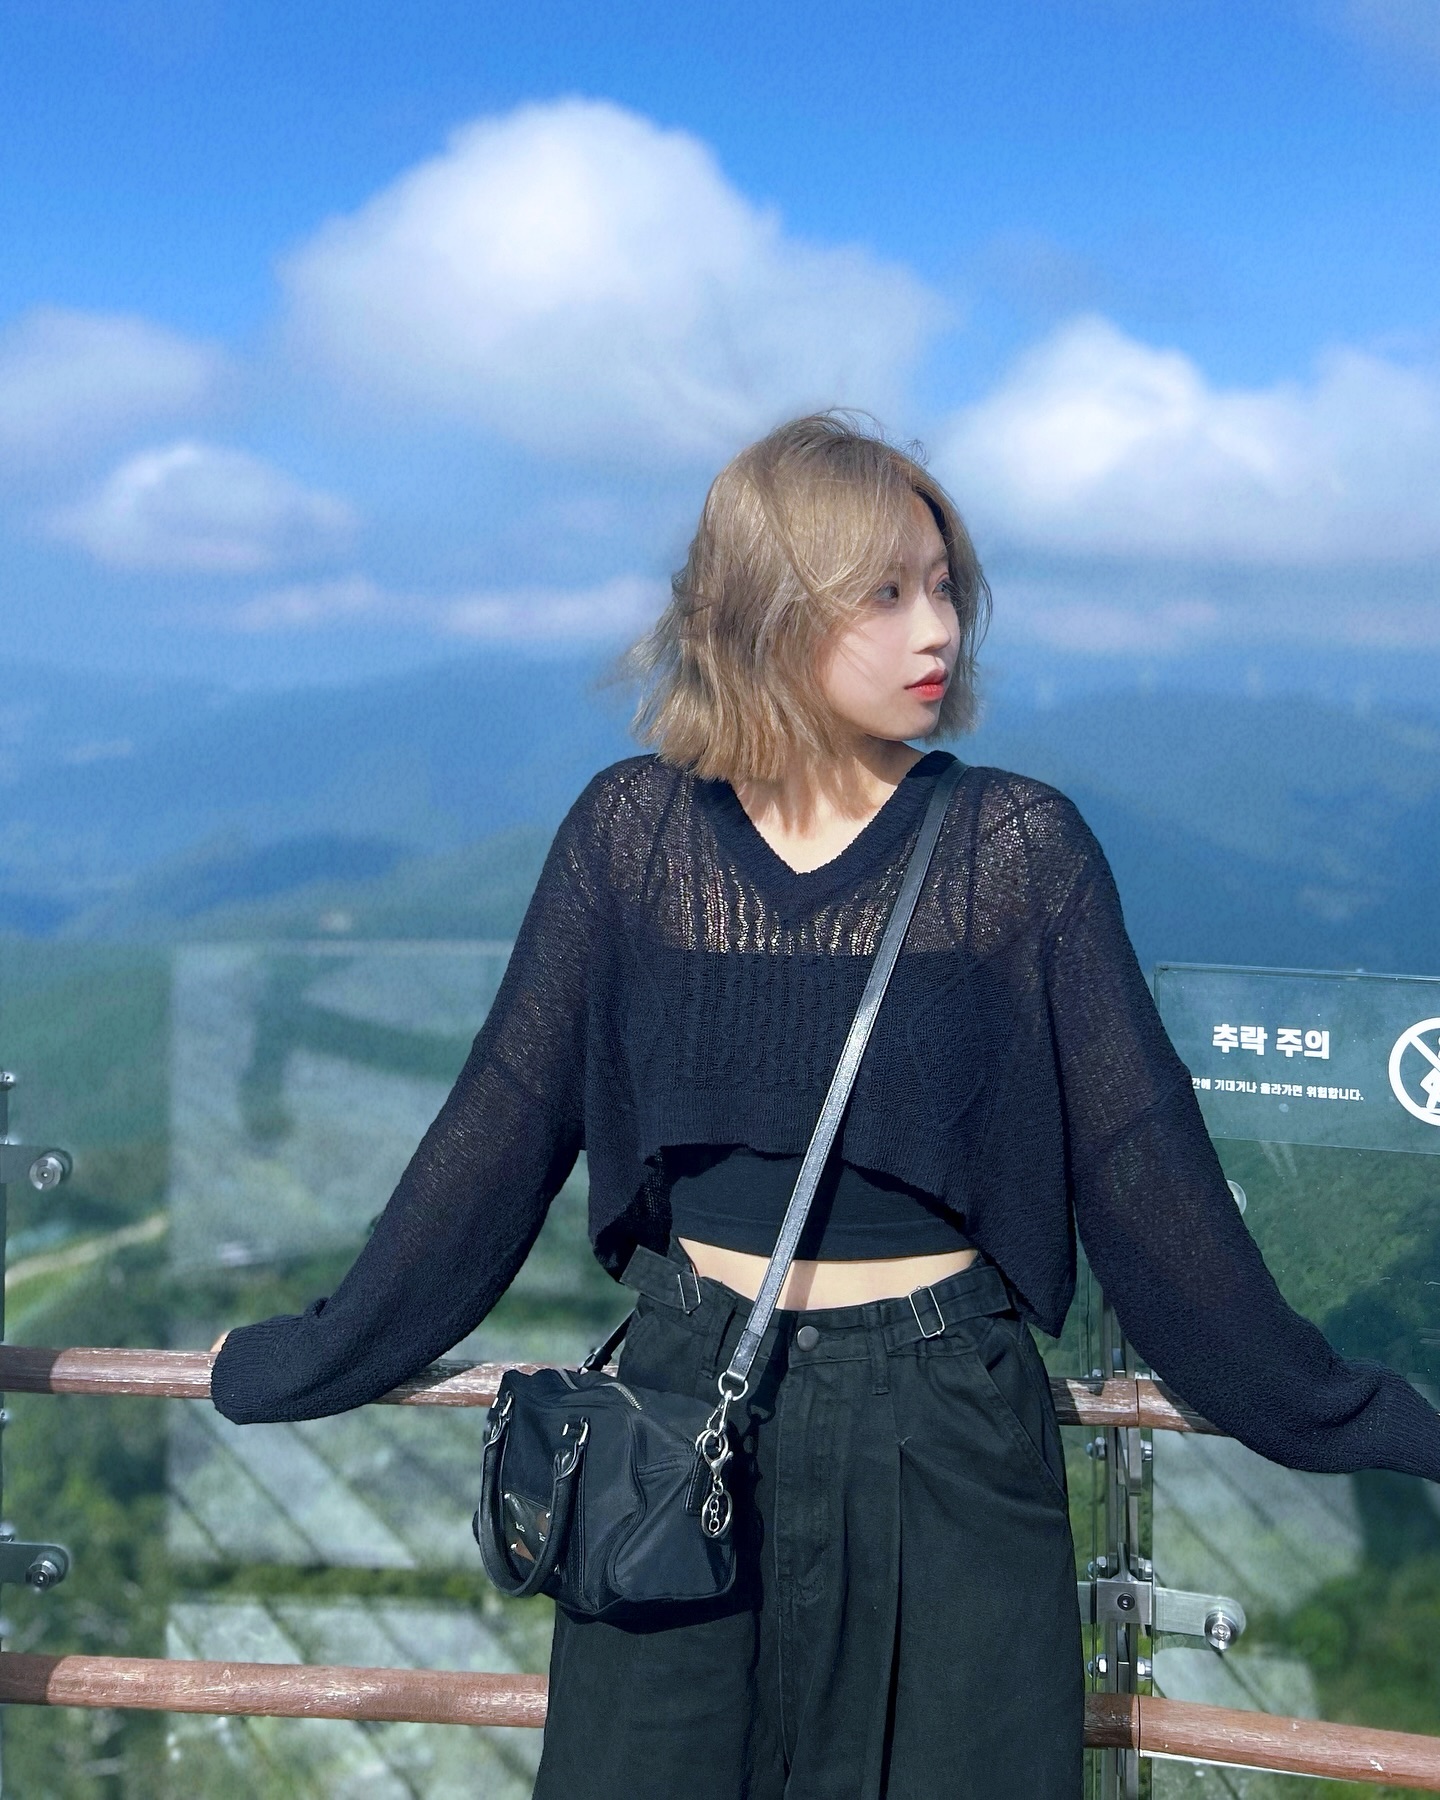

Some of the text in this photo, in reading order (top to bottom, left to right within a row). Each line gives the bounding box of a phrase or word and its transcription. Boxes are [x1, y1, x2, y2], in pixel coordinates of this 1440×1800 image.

[1212, 1023, 1330, 1060] 추락 주의
[1191, 1077, 1365, 1101] 간에 기대거나 올라가면 위험합니다.
